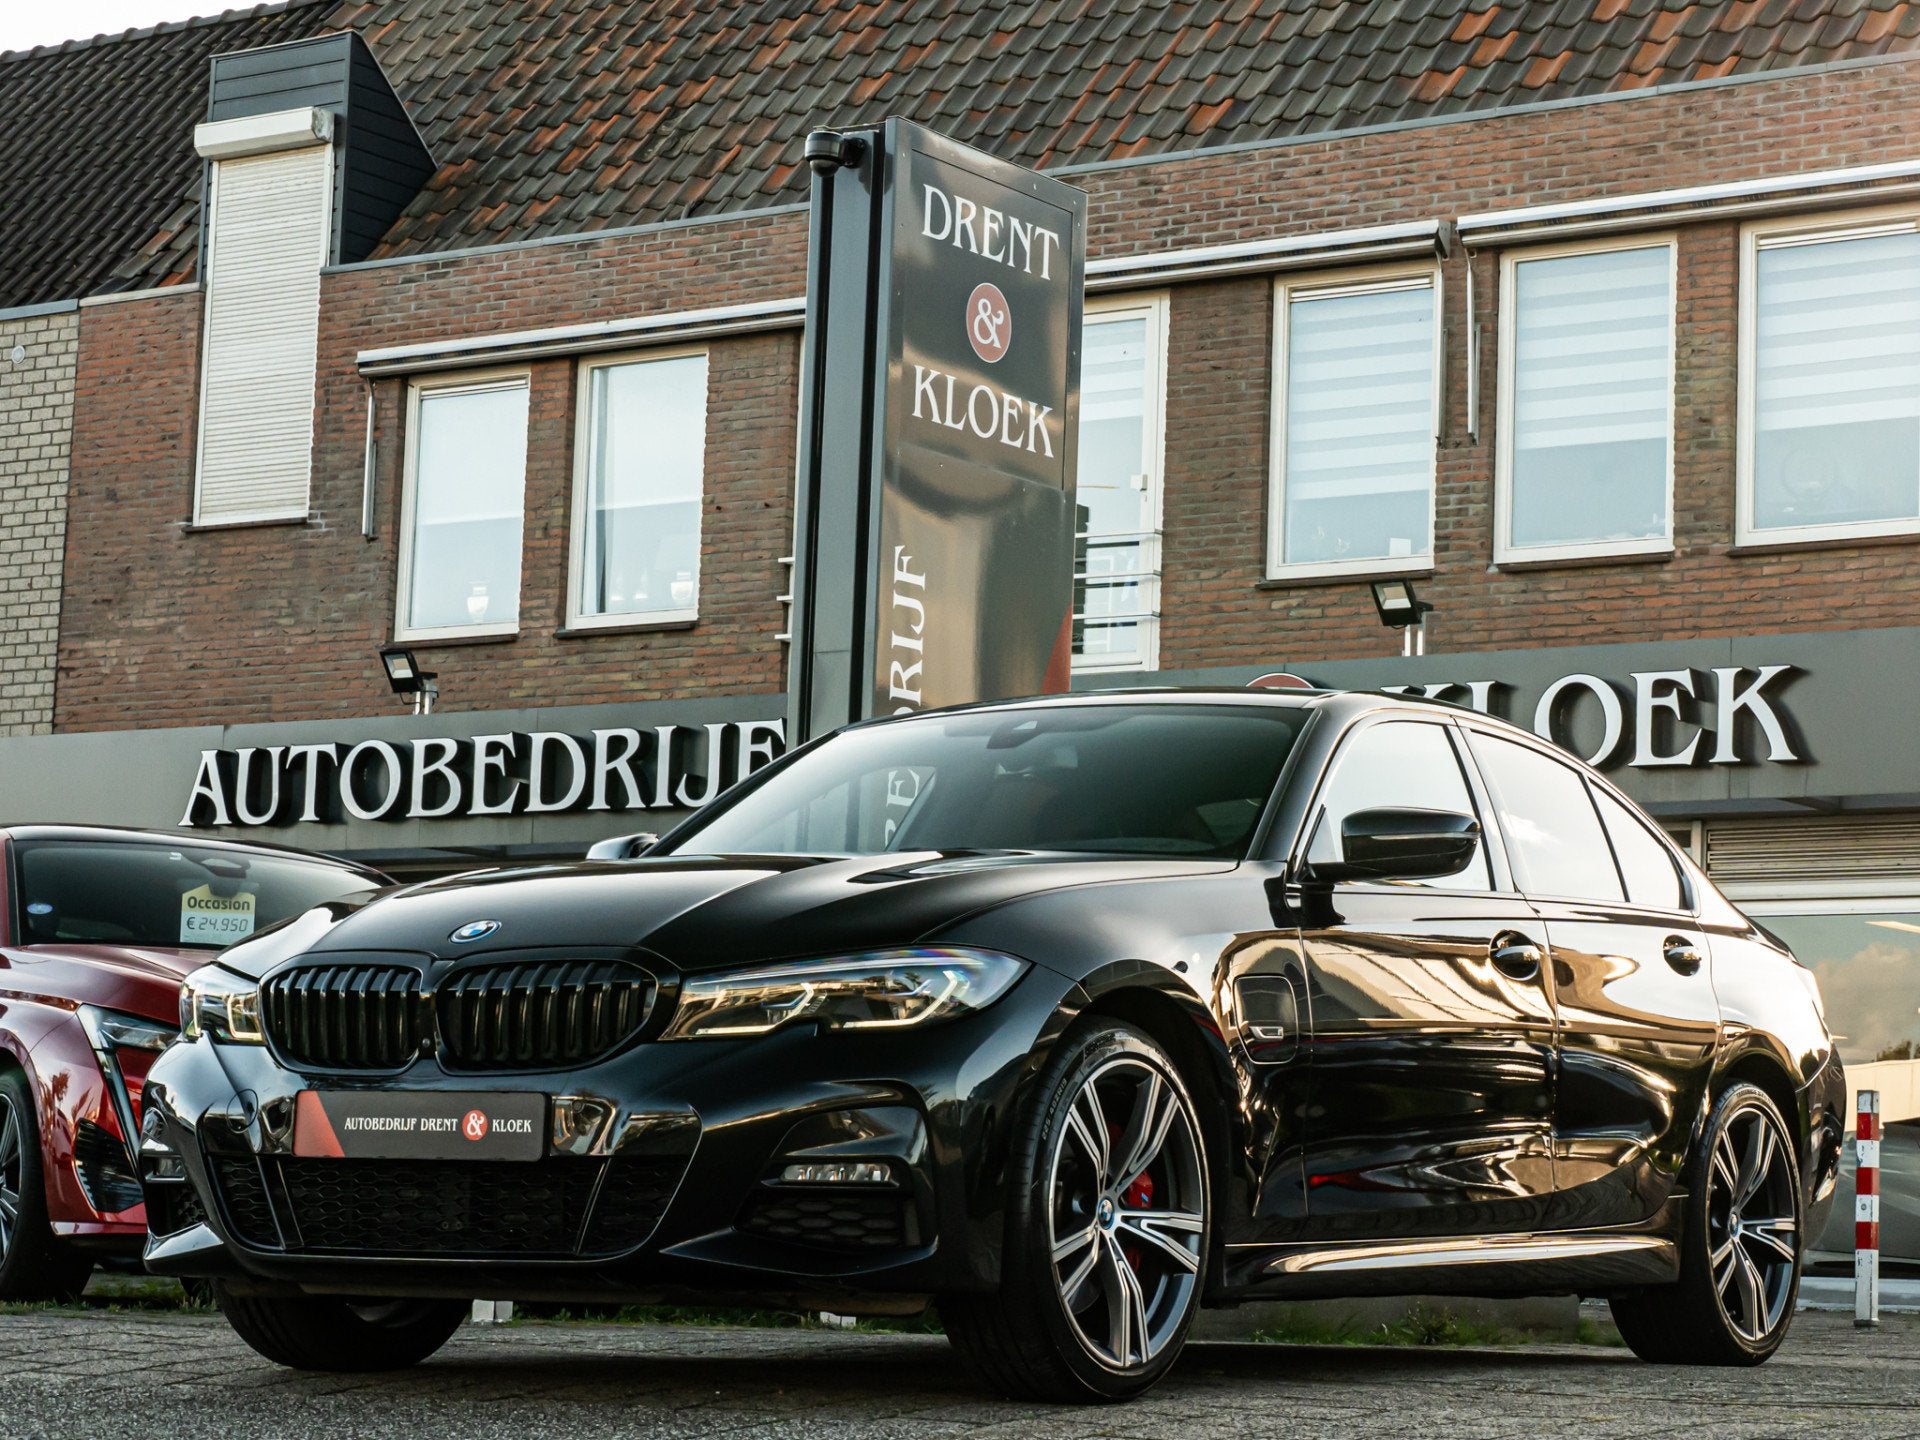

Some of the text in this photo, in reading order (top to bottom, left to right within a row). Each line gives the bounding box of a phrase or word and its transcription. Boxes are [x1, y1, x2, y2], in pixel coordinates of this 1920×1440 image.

[922, 183, 1060, 281] DRENT
[973, 298, 1005, 348] &
[912, 365, 1055, 459] KLOEK
[177, 718, 786, 827] AUTOBEDRIJF
[187, 896, 251, 911] Occasion
[344, 1112, 532, 1137] AUTOBEDRIJF DRENT & KLOEK
